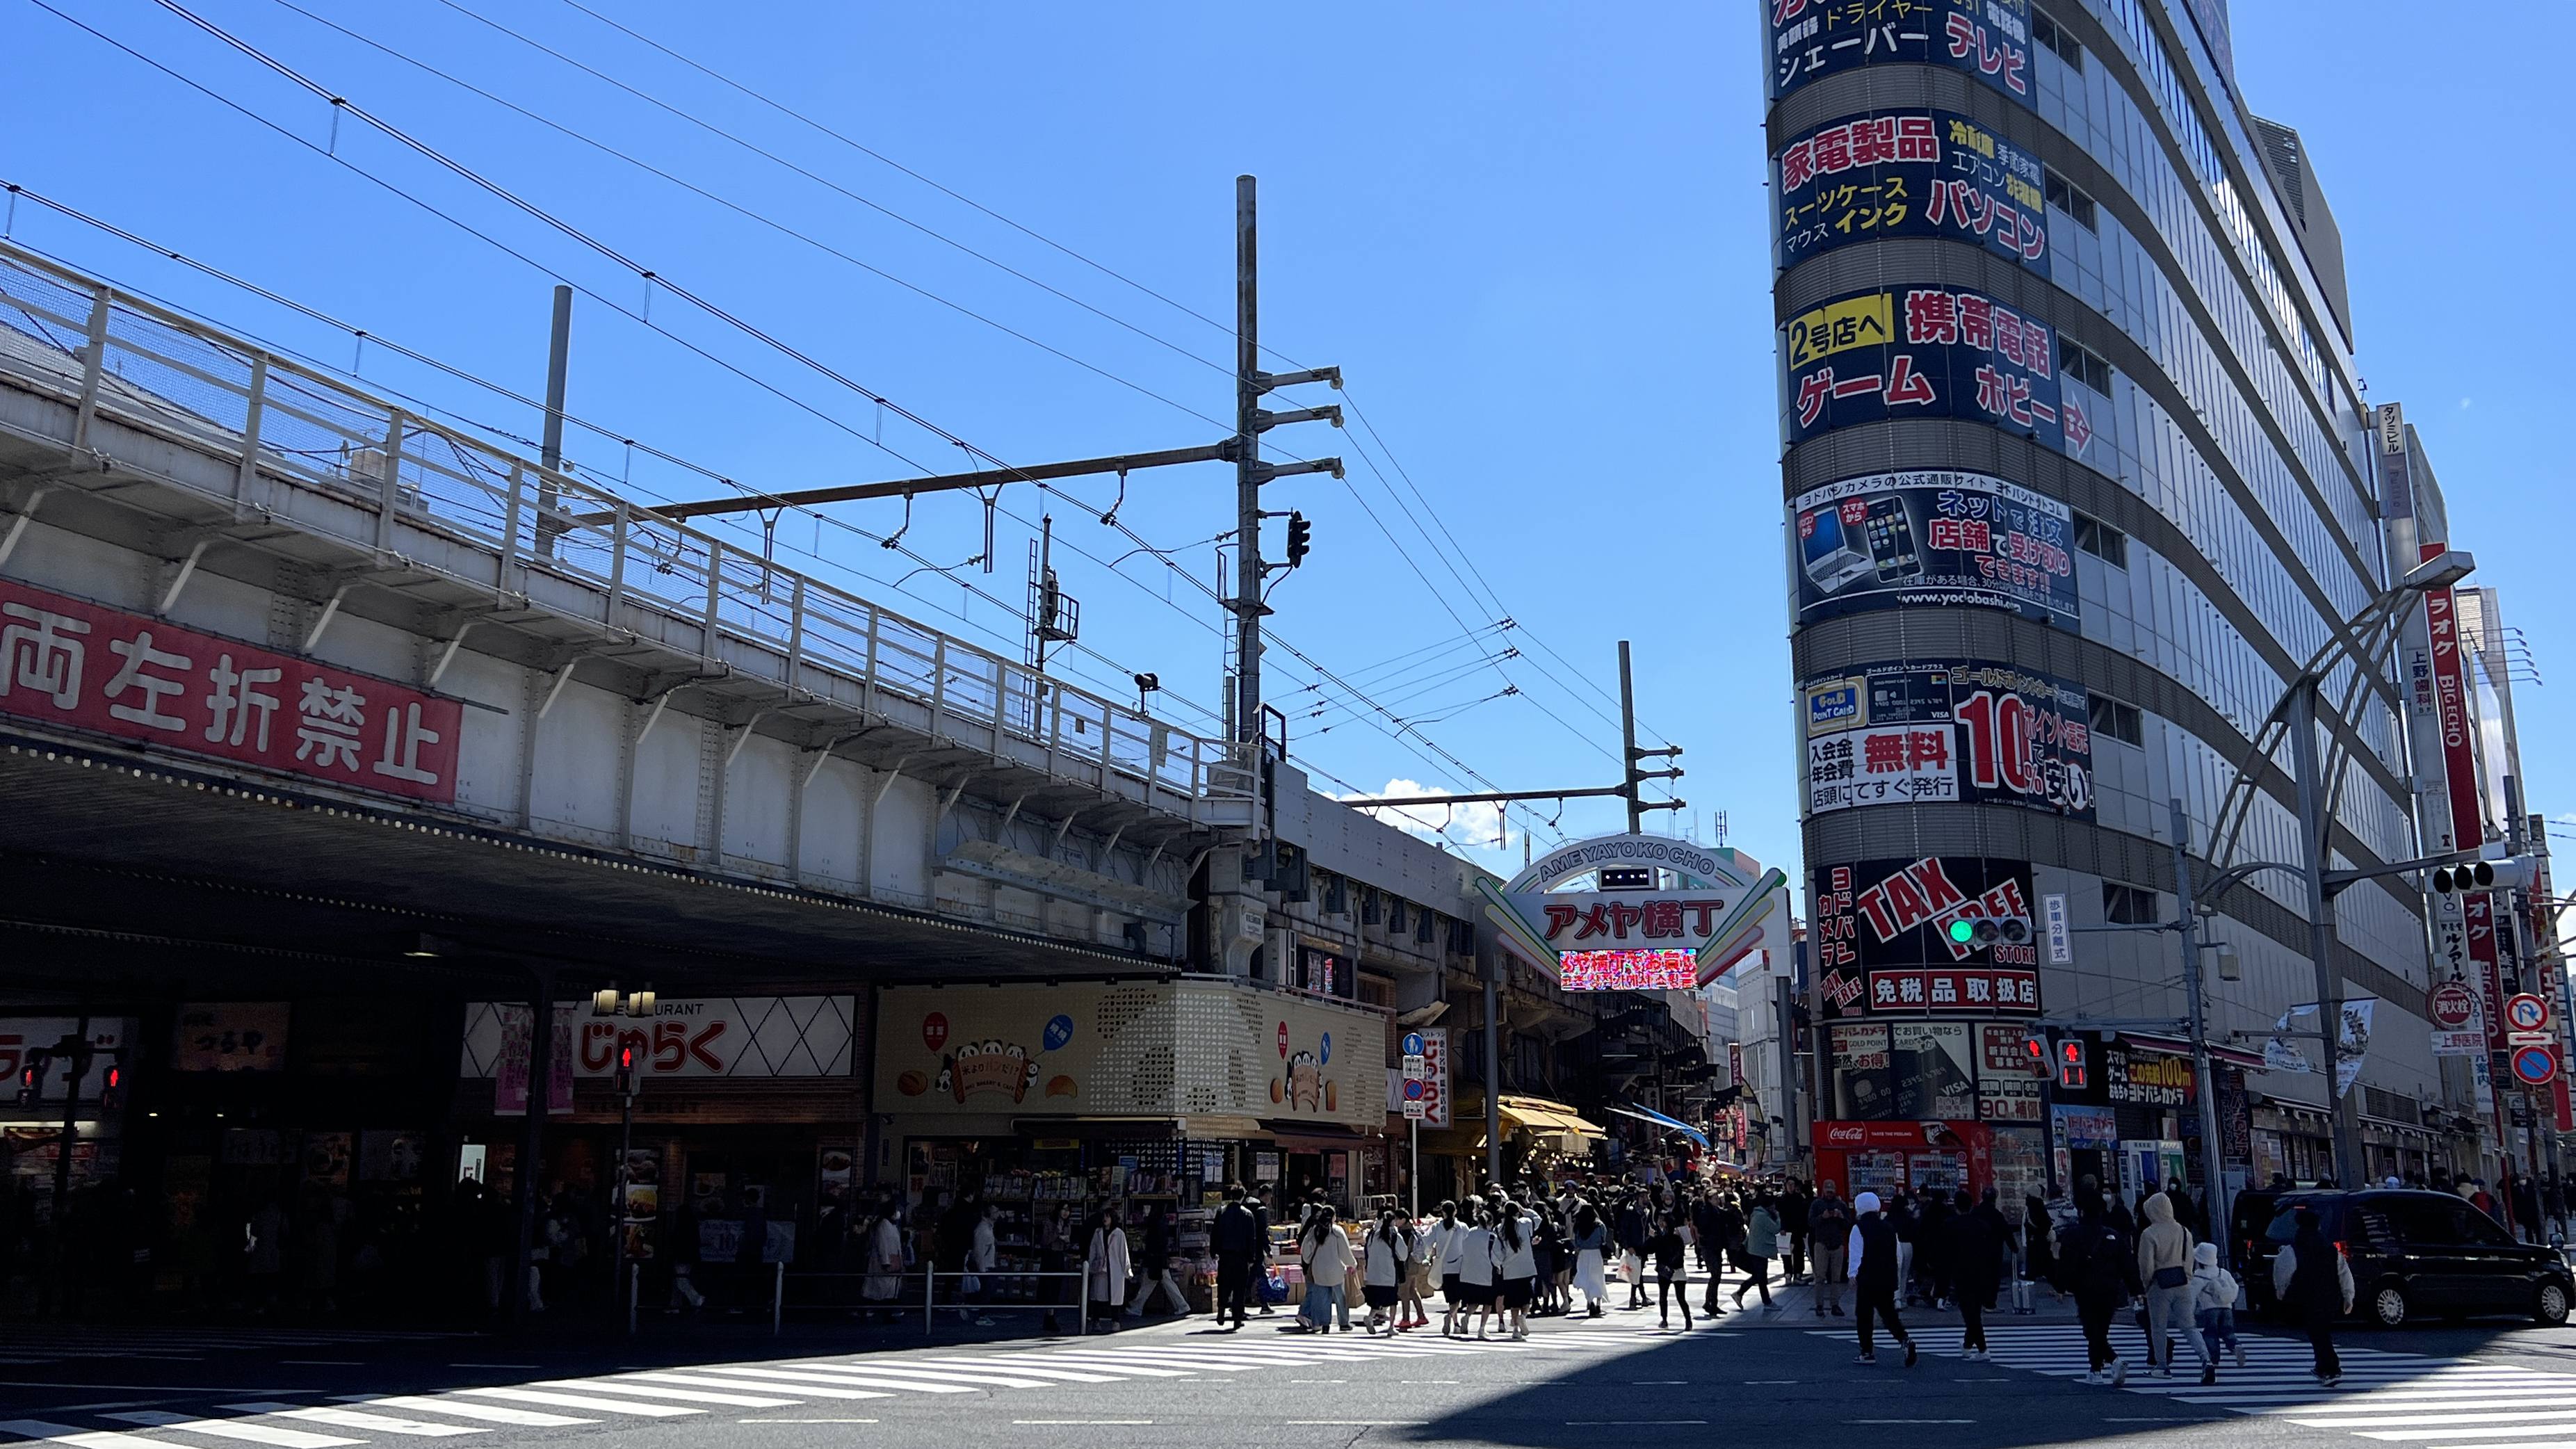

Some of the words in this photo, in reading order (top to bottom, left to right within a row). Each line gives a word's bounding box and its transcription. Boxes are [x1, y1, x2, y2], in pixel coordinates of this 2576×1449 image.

[1780, 22, 1929, 88] シェーバー
[1947, 11, 2026, 95] テレビ
[1782, 116, 1939, 195] 家電製品
[1952, 150, 2005, 186] エアコン
[1785, 177, 1909, 231] スーツケース
[1835, 202, 1907, 233] インク
[1925, 179, 2045, 260] パソコン
[1785, 222, 1829, 253] マウス
[1791, 316, 1886, 366] 2号店へ
[1905, 290, 2052, 381] 携帯電話
[1797, 355, 1936, 429] ゲーム
[1976, 364, 2057, 428] ホビー
[2383, 407, 2399, 453] タツミビル
[1804, 473, 1987, 506] ヨドバシカメラの公式通販サイト
[1842, 501, 1865, 515] スマホ
[1846, 513, 1863, 524] から
[1937, 490, 2063, 547] ネットで注文
[1928, 517, 2071, 577] 店舗で受け取り
[0, 601, 440, 786] 両左折禁止
[2411, 651, 2432, 706] 上野歯科
[2438, 674, 2456, 704] BIG
[2445, 705, 2463, 748] ECHO
[1812, 738, 1854, 763] 入会金
[1864, 730, 1949, 774] 無料
[1812, 759, 1854, 784] 年会費
[1813, 776, 1953, 809] 店頭にてすぐ発行
[1540, 842, 1716, 883] AMEYAYOKOCHO
[1544, 900, 1724, 940] アメヤ横丁
[1832, 866, 1856, 966] ヨドバシ
[1858, 857, 1968, 944] TAX
[1818, 893, 1834, 967] カメラ
[2048, 899, 2066, 960] 歩車分離式
[1993, 944, 2036, 965] STORE
[1820, 968, 1845, 1001] TAX
[1833, 976, 1864, 1010] FREE
[1876, 978, 2036, 1004] 免税品取扱店
[2436, 998, 2471, 1015] 消火栓
[1831, 1026, 1887, 1037] ヨドバシカメラ
[1893, 1026, 1963, 1036] でお買い物なら
[1941, 1080, 1970, 1096] VISA
[2107, 1065, 2128, 1083] ゲーム
[2128, 1083, 2184, 1106] ヨドバシカメラ
